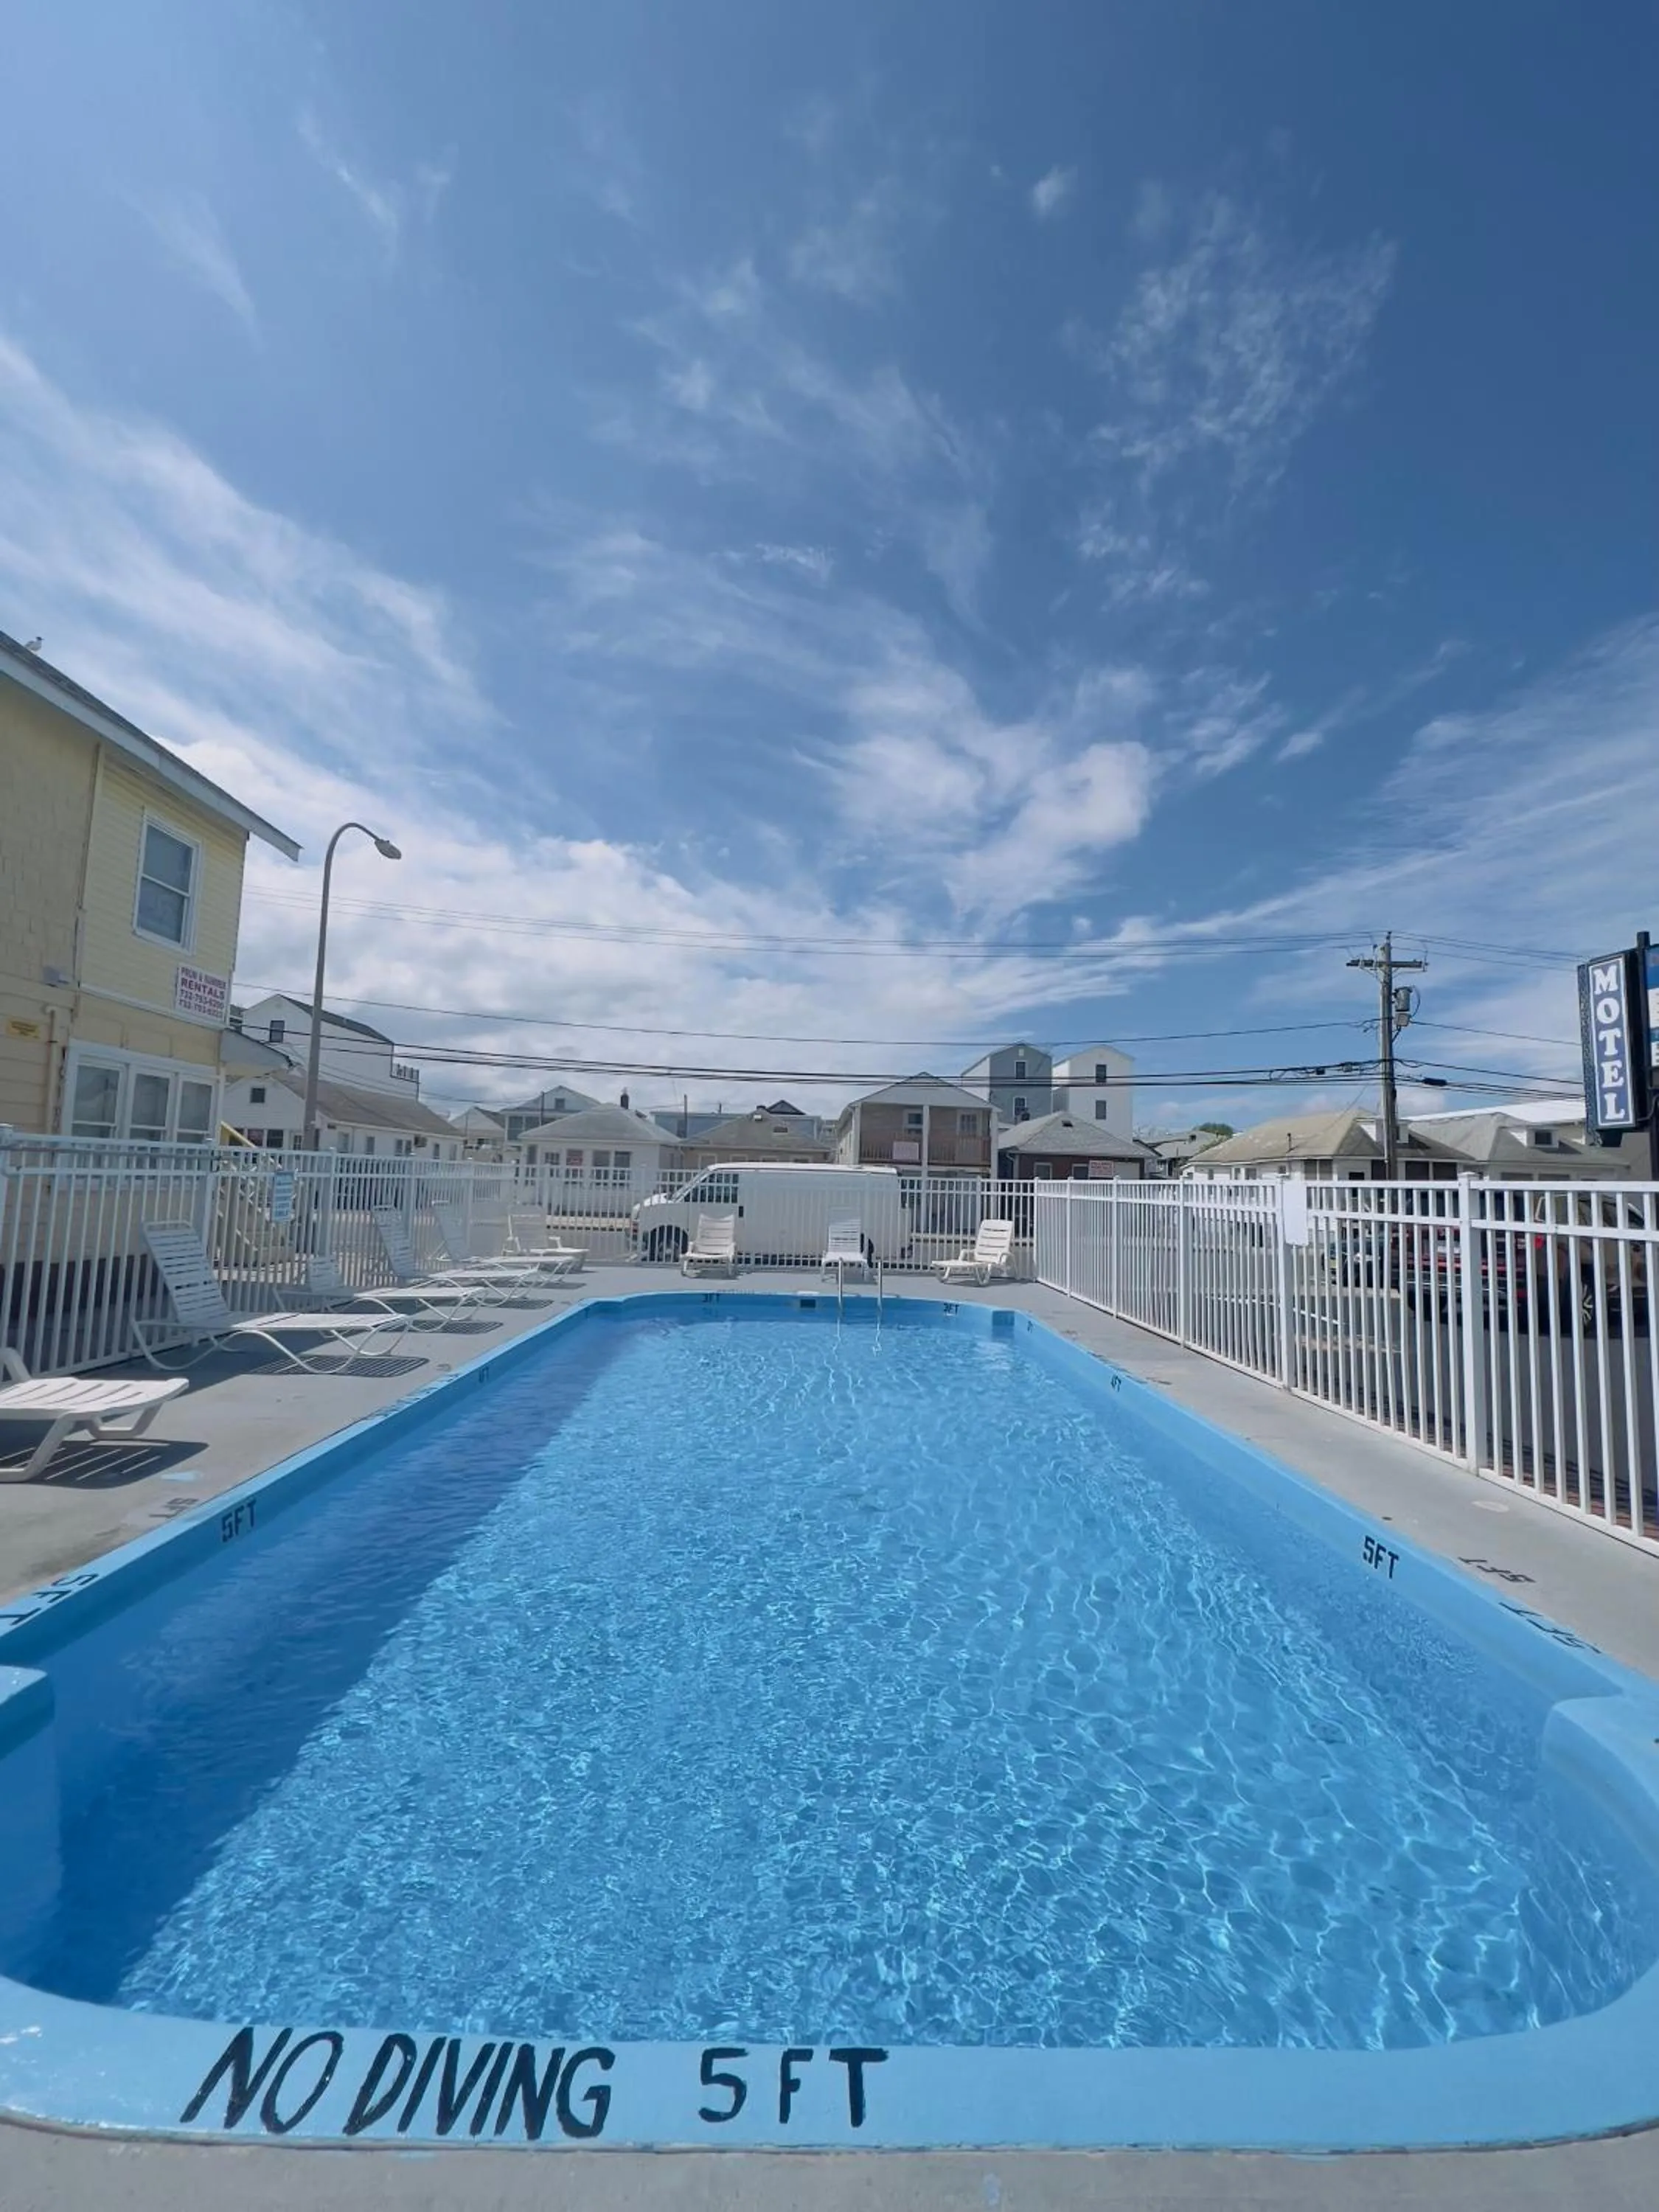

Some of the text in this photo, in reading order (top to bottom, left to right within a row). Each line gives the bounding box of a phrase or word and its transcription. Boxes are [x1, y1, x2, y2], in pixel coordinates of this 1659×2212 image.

[181, 978, 225, 1001] RENTALS
[1593, 964, 1626, 1121] MOTEL
[221, 1497, 257, 1543] 5FT
[1363, 1535, 1399, 1579] 5FT
[179, 2027, 344, 2133] NO
[342, 2033, 616, 2140] DIVING
